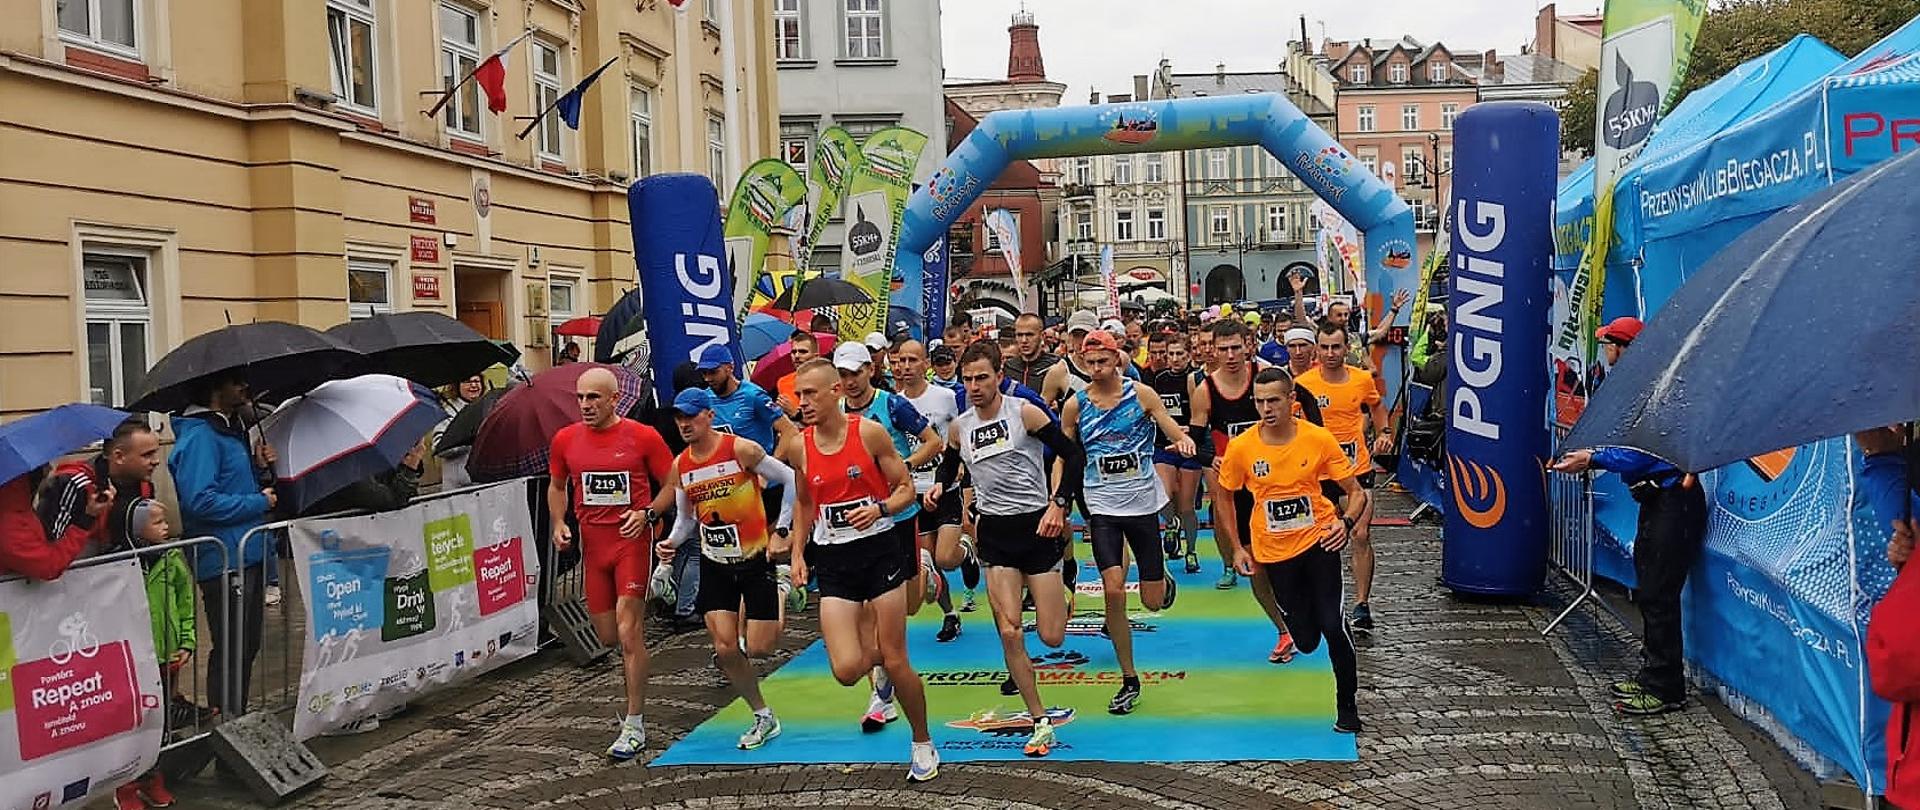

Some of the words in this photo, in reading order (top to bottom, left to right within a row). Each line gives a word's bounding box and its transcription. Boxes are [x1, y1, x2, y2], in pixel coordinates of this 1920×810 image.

[675, 253, 730, 364] NiG
[1452, 199, 1506, 440] PGNiG
[977, 429, 998, 442] 943
[1107, 458, 1129, 470] 779
[595, 479, 616, 490] 219
[1277, 504, 1298, 517] 127
[326, 579, 361, 600] Open
[397, 588, 425, 610] Drink
[32, 671, 103, 709] Repeat
[81, 691, 113, 710] znova
